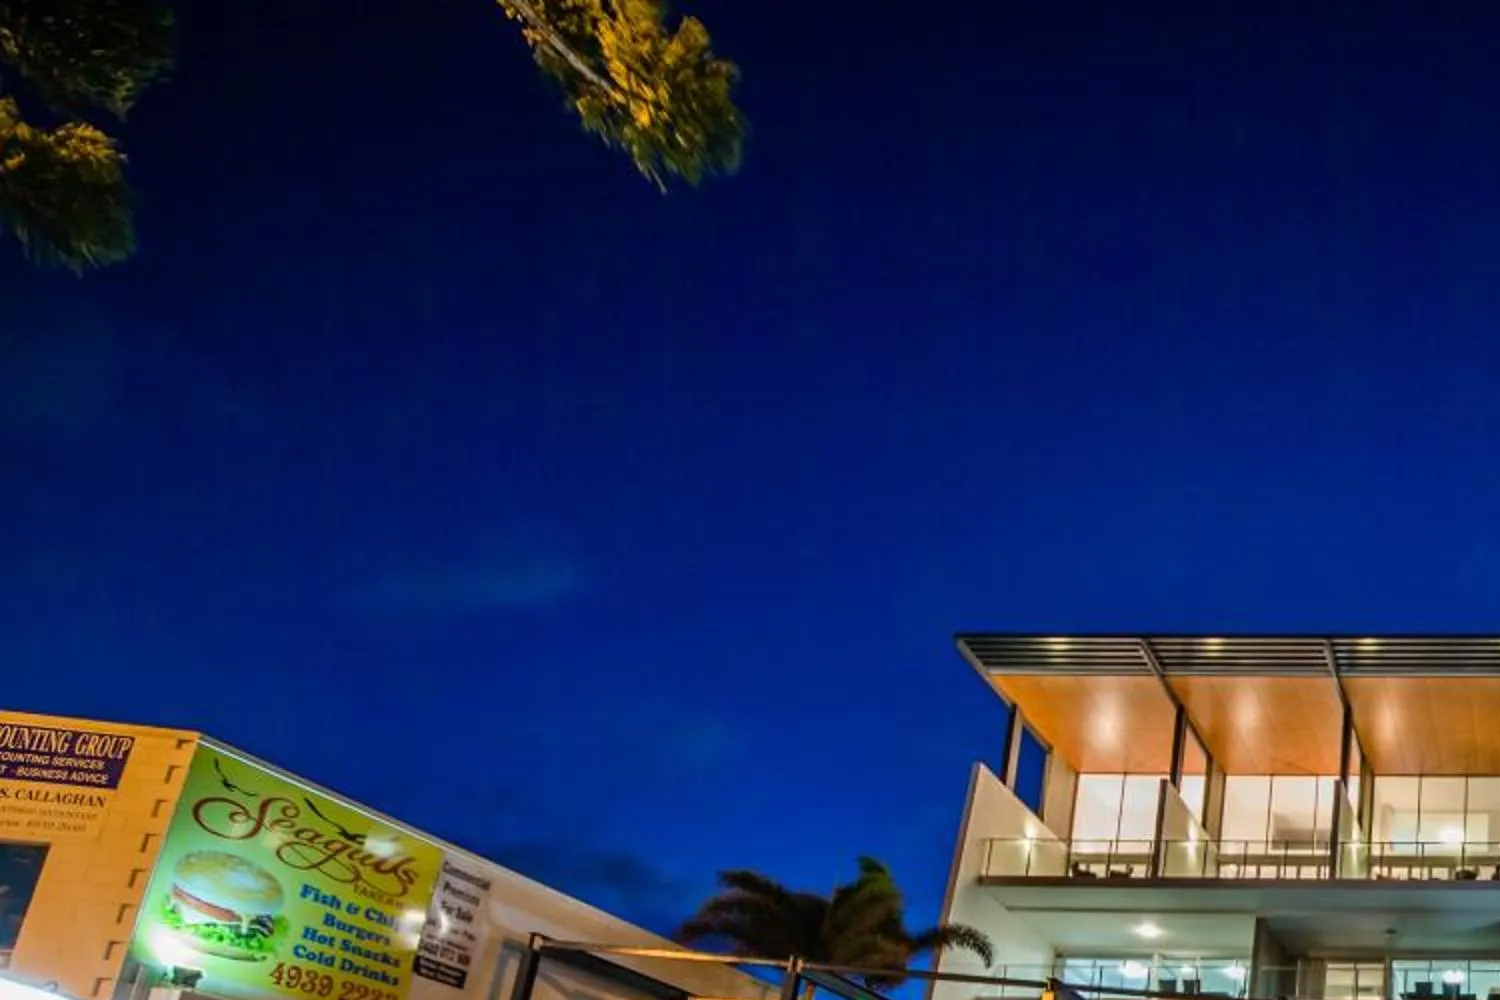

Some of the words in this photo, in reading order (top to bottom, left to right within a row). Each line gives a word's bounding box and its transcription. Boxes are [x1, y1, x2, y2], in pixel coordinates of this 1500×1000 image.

[0, 725, 73, 753] OUNTING
[75, 734, 132, 760] GROUP
[0, 752, 50, 765] OUNTING
[52, 756, 105, 770] SERVICES
[15, 766, 69, 781] BUSINESS
[70, 771, 109, 785] ADVICE
[15, 788, 108, 808] CALLAGHAN
[300, 883, 341, 910] Fish
[323, 912, 391, 946] Burgers
[302, 926, 336, 947] Hot
[339, 938, 400, 968] Snacks
[269, 961, 334, 998] 4939
[293, 944, 336, 968] Cold
[340, 957, 399, 987] Drinks
